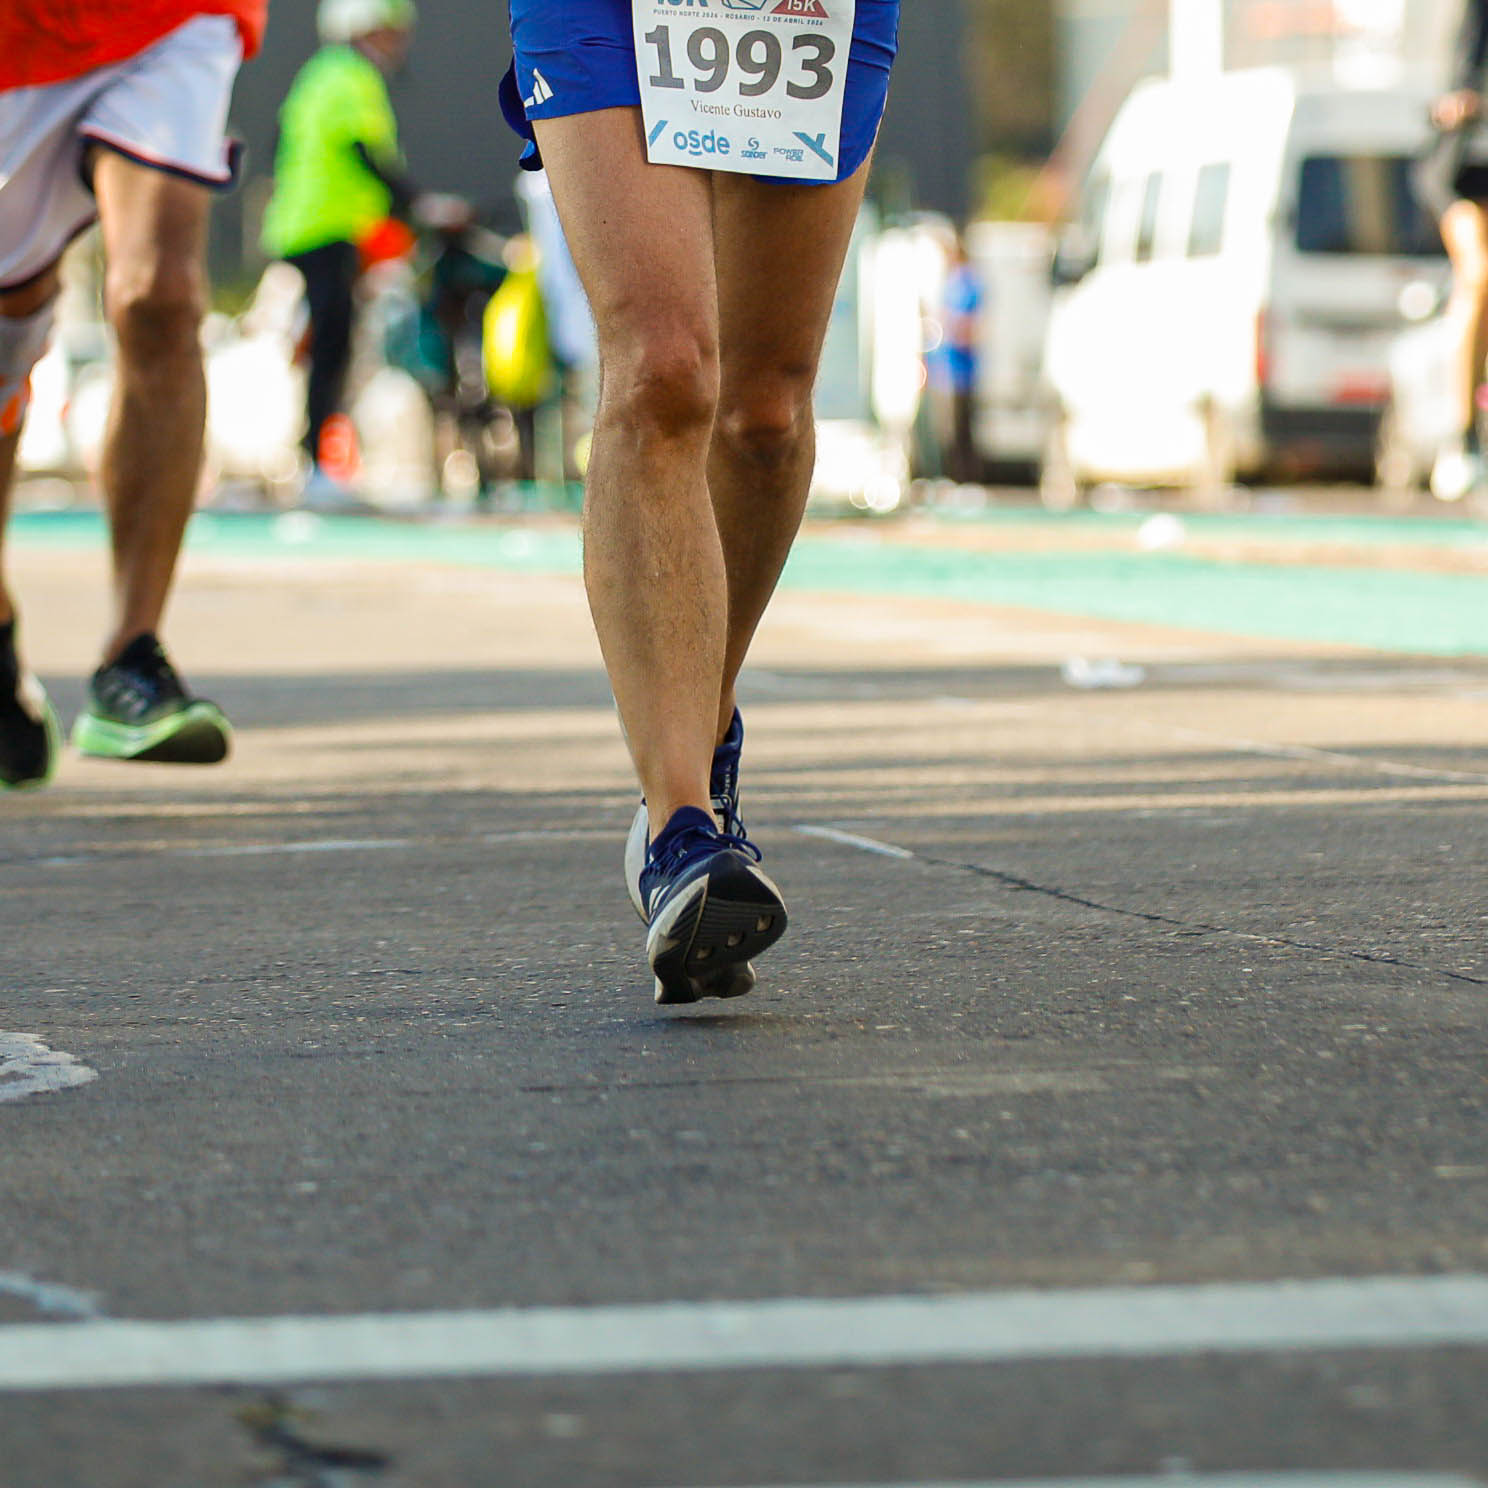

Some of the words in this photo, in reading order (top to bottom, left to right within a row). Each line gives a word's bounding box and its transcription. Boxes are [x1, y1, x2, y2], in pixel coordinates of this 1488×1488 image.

[653, 9, 678, 17] PUERTO
[679, 10, 700, 18] NORTE
[725, 12, 755, 21] ROSARIO
[783, 17, 805, 25] ABRIL
[644, 24, 837, 100] 1993
[690, 99, 731, 116] Vicente
[733, 104, 782, 120] Gustavo
[673, 129, 731, 156] osde
